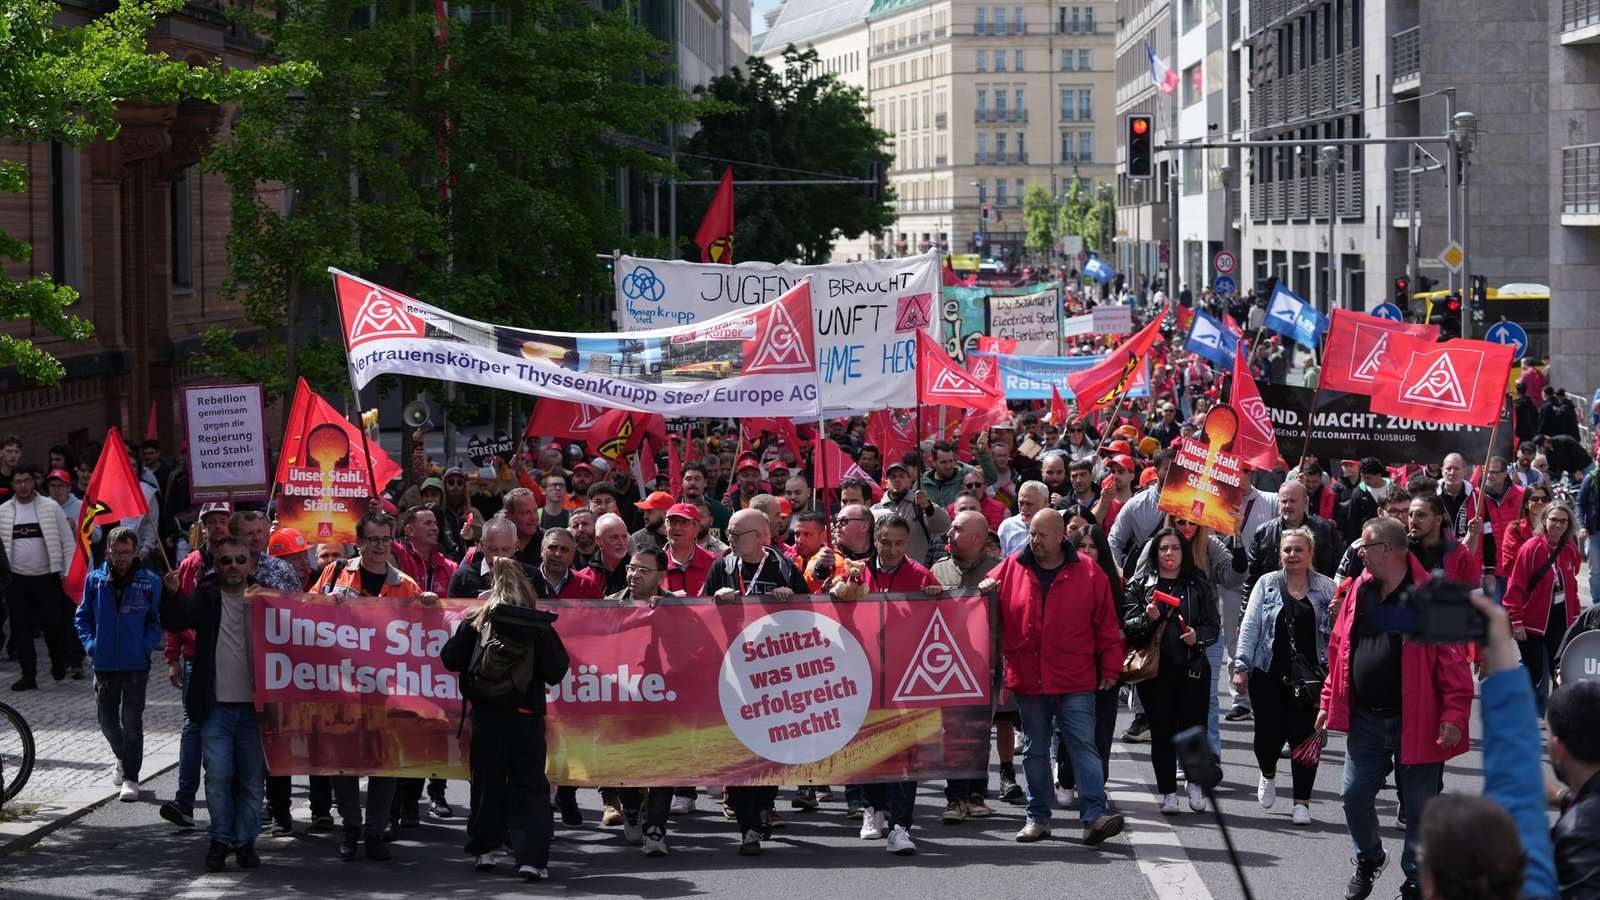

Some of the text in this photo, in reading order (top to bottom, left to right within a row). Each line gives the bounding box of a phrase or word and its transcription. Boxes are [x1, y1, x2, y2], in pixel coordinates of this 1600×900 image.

[1218, 257, 1231, 269] 30
[700, 272, 914, 305] JUGEN BRAUCHT
[818, 305, 888, 335] UNFT
[819, 344, 865, 385] HME
[352, 350, 816, 406] Vertrauenskörper ThyssenKrupp Steel Europe AG
[1006, 374, 1071, 391] Rassel
[197, 394, 246, 406] Rebellion
[198, 407, 248, 418] gemeinsam
[1309, 412, 1382, 428] MACHT.
[203, 418, 245, 431] gegen die
[198, 432, 253, 444] Regierung
[1274, 428, 1416, 442] GEND ACELORMITTAL DUISBURG
[200, 445, 254, 456] und Stahl-
[1184, 440, 1240, 472] Unser Stahl.
[201, 458, 254, 469] konzerne!
[1177, 453, 1240, 488] Deutschlands
[289, 470, 364, 483] Unser Stahl.
[1186, 474, 1220, 497] Stärke.
[284, 484, 369, 498] Deutschlands
[303, 498, 348, 512] Stärke.
[264, 607, 461, 657] Unser Sta
[743, 626, 831, 662] Schützt,
[749, 656, 836, 690] was uns
[1585, 657, 1600, 675] U
[264, 652, 463, 700] Deutschla
[740, 676, 858, 721] erfolgreich
[768, 707, 842, 744] macht!
